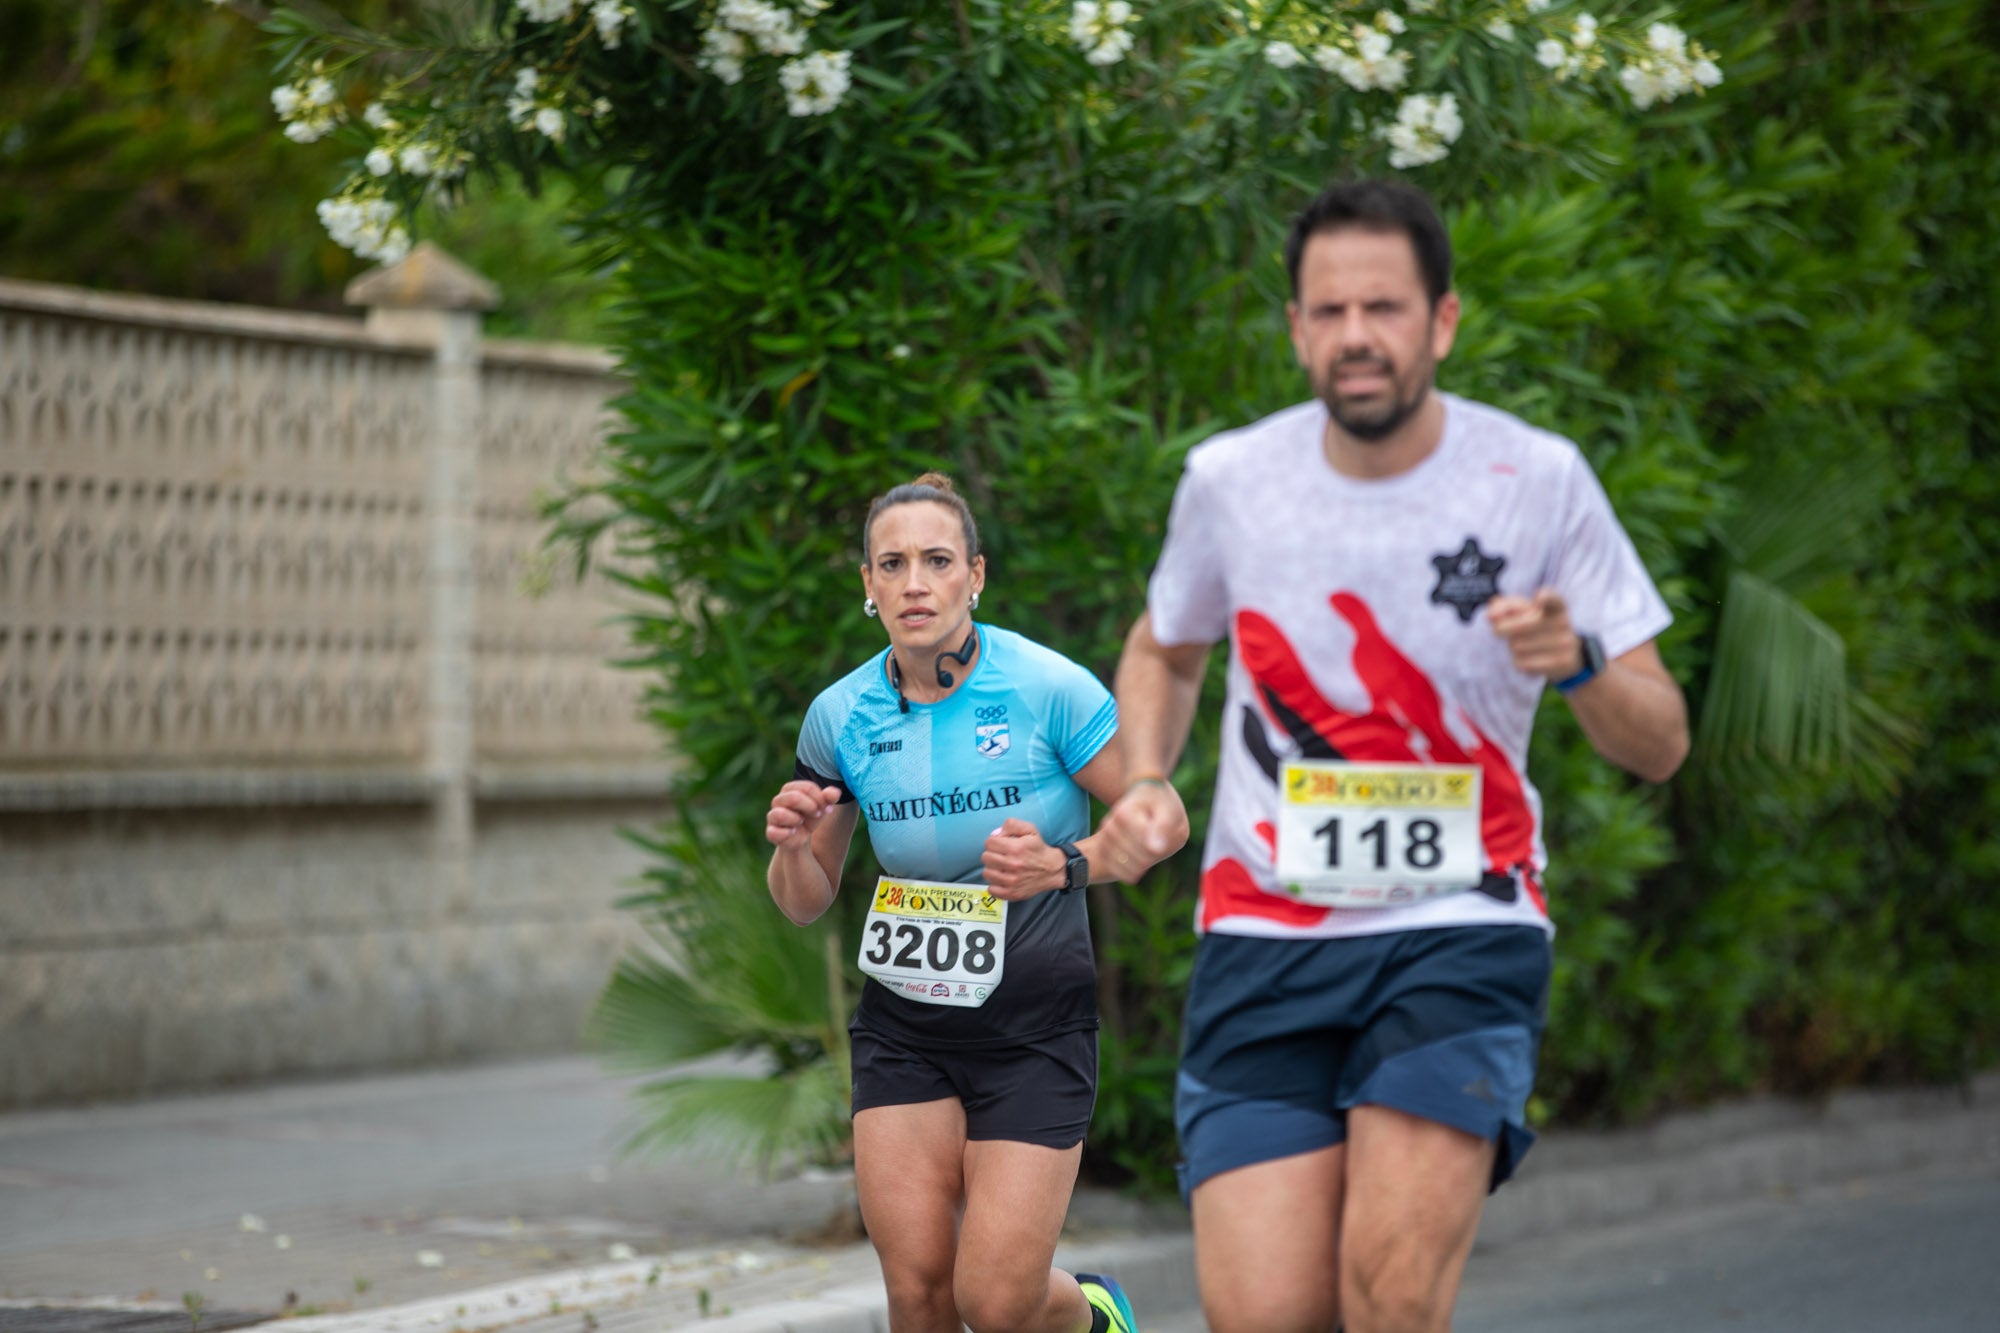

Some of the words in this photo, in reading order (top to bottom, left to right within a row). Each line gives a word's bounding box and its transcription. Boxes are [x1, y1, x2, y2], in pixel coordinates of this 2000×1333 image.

[869, 785, 1022, 822] ALMUÑÉCAR
[1313, 816, 1444, 870] 118
[886, 887, 904, 906] 38
[930, 889, 967, 899] PREMIO
[866, 920, 996, 975] 3208
